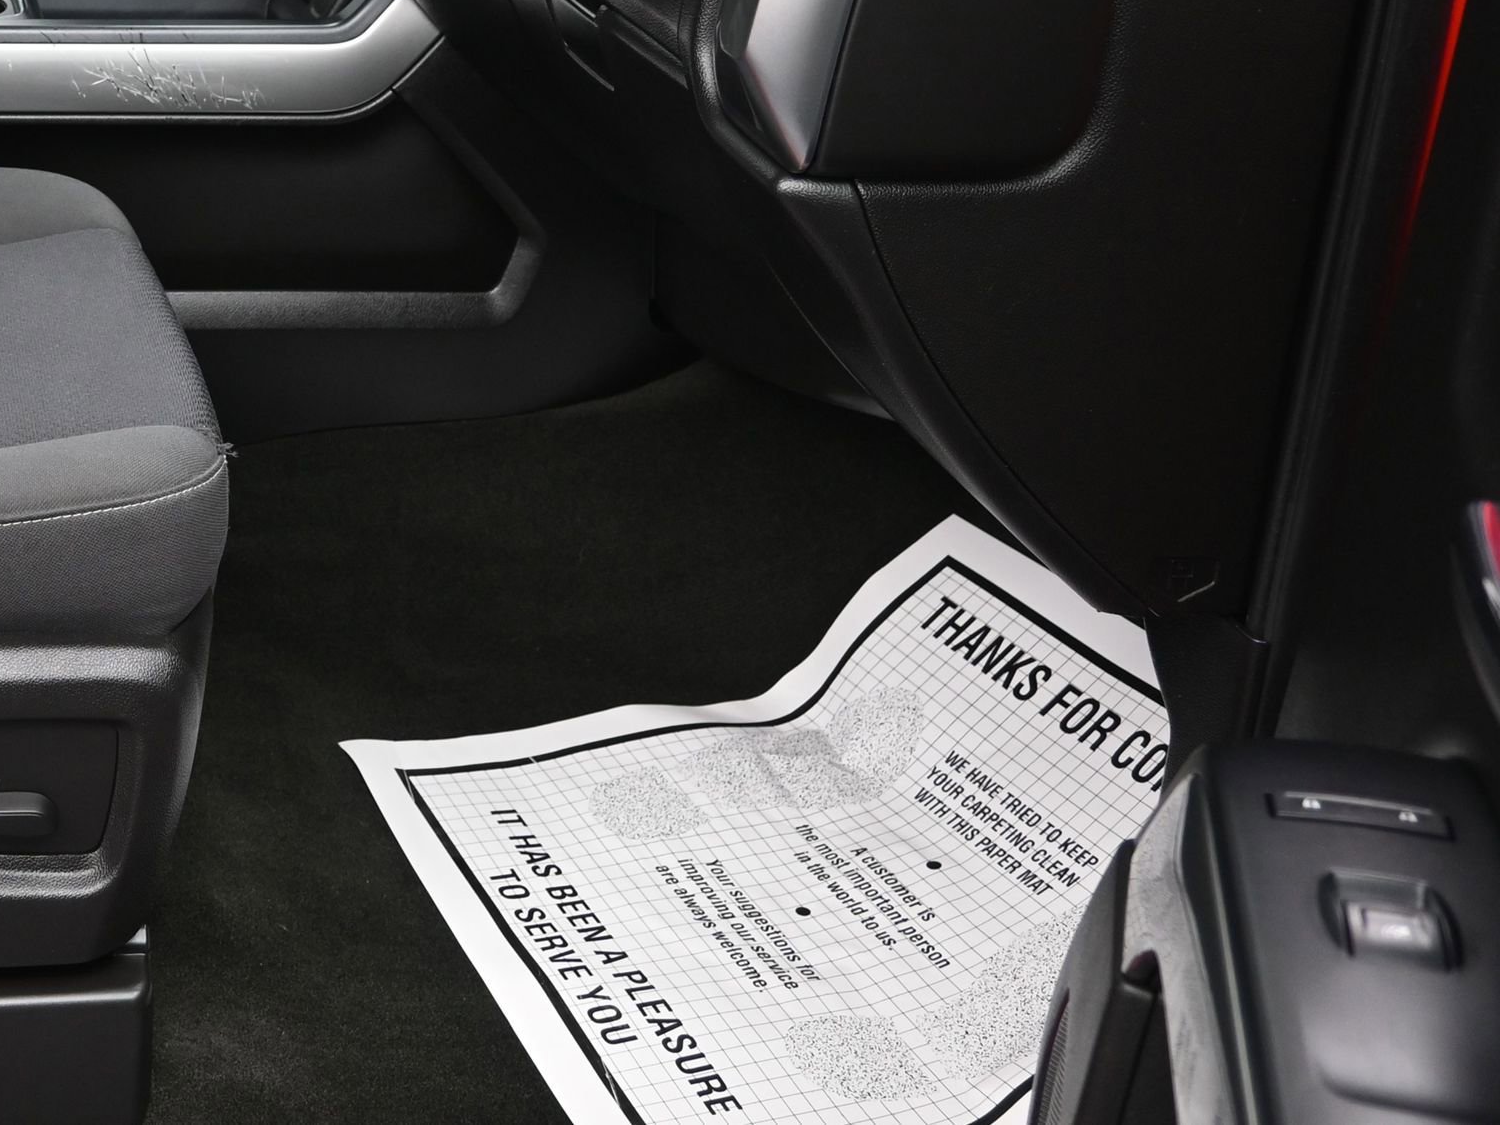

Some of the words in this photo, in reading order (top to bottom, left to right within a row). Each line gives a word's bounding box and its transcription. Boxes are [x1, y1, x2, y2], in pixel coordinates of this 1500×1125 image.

[921, 595, 1052, 701] THANKS
[1039, 683, 1121, 752] FOR
[1111, 730, 1169, 792] CO
[490, 809, 529, 827] IT
[508, 834, 562, 878] HAS
[914, 787, 952, 818] WITH
[947, 813, 980, 841] THIS
[975, 836, 1022, 874] PAPER
[1017, 869, 1053, 895] MAT
[926, 766, 965, 800] YOUR
[960, 794, 1035, 854] CARPETING
[1031, 849, 1080, 888] CLEAN
[944, 750, 971, 774] WE
[965, 767, 1004, 799] HAVE
[1000, 792, 1042, 827] TRIED
[1039, 821, 1062, 843] TO
[1058, 837, 1099, 867] KEEP
[545, 884, 614, 943] BEEN
[655, 865, 679, 885] are
[674, 887, 717, 929] always
[712, 931, 768, 993] welcome.
[677, 858, 736, 920] improving
[730, 922, 756, 942] our
[751, 945, 799, 990] service
[705, 859, 735, 888] Your
[729, 890, 802, 962] suggestions
[796, 964, 821, 981] for
[794, 851, 811, 863] in
[807, 863, 831, 881] the
[827, 881, 868, 916] world
[861, 915, 879, 930] to
[875, 930, 897, 950] us.
[795, 824, 819, 842] the
[815, 843, 851, 869] most
[843, 868, 908, 925] important
[898, 926, 951, 969] person
[850, 847, 868, 857] A
[861, 856, 922, 908] customer
[917, 907, 936, 922] is
[489, 868, 531, 900] TO
[514, 907, 593, 980] SERVE
[576, 985, 638, 1045] YOU
[594, 950, 628, 965] A
[612, 969, 743, 1115] PLEASURE
